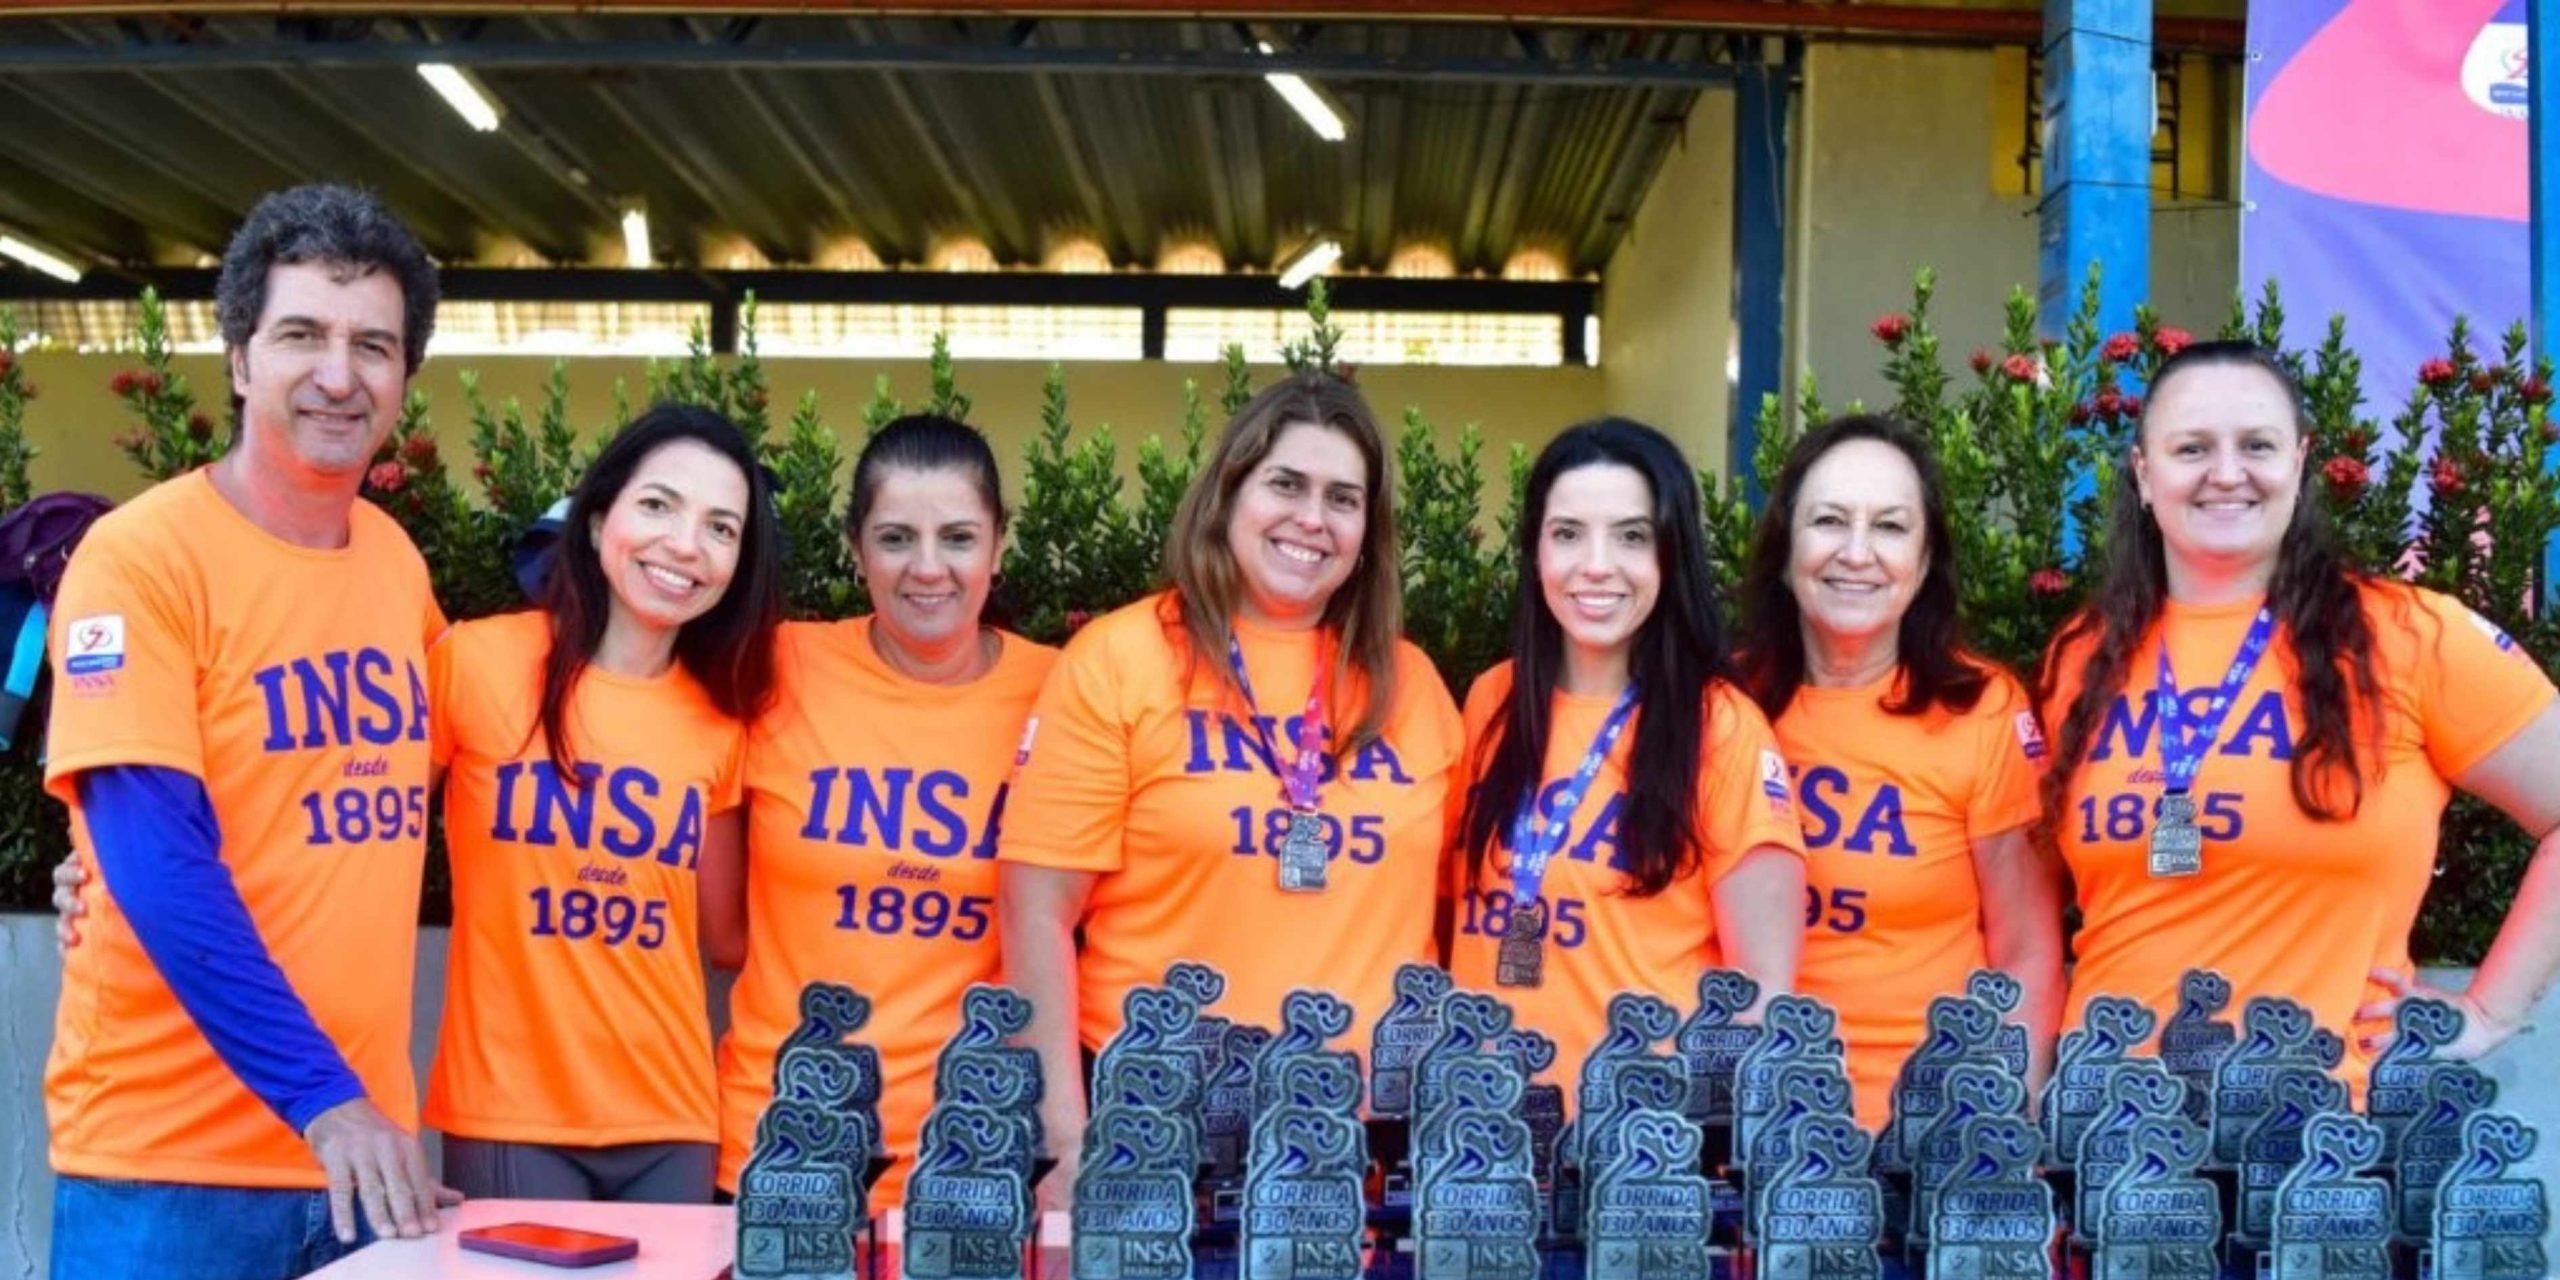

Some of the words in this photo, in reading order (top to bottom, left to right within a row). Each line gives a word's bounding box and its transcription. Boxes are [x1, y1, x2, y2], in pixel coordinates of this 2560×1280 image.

[344, 755, 388, 777] desde
[302, 786, 425, 844] 1895
[492, 760, 701, 870] INSA
[578, 863, 626, 885] desde
[888, 862, 941, 880] desde
[530, 886, 667, 949] 1895
[834, 884, 993, 941] 1895
[749, 1173, 841, 1195] CORRIDA
[917, 1181, 1008, 1200] CORRIDA
[1083, 1182, 1178, 1202] CORRIDA
[1256, 1183, 1350, 1203] CORRIDA
[1433, 1185, 1525, 1207] CORRIDA
[1605, 1187, 1697, 1207] CORRIDA
[1775, 1190, 1869, 1209] CORRIDA
[1946, 1191, 2039, 1211] CORRIDA
[2114, 1192, 2206, 1210] CORRIDA
[2288, 1190, 2380, 1209] CORRIDA
[2449, 1187, 2537, 1206] CORRIDA
[747, 1202, 780, 1220] 130
[785, 1202, 842, 1219] ANOS
[914, 1206, 947, 1224] 130
[951, 1207, 1009, 1226] ANOS
[1081, 1209, 1114, 1228] 130
[1119, 1209, 1178, 1228] ANOS
[1254, 1210, 1286, 1230] 130
[1292, 1210, 1351, 1231] ANOS
[1429, 1214, 1461, 1232] 130
[1467, 1214, 1526, 1231] ANOS
[1602, 1215, 1634, 1232] 130
[1640, 1215, 1698, 1232] ANOS
[1773, 1218, 1806, 1237] 130
[1810, 1218, 1870, 1237] ANOS
[1943, 1219, 1976, 1238] 130
[1981, 1219, 2041, 1238] ANOS
[2111, 1219, 2144, 1237] 130
[2150, 1219, 2208, 1237] ANOS
[2284, 1218, 2318, 1237] 130
[2323, 1218, 2380, 1237] ANOS
[2446, 1214, 2479, 1234] 130
[2484, 1213, 2539, 1232] ANOS
[788, 1232, 845, 1257] INSA
[957, 1238, 1011, 1261] INSA
[1126, 1240, 1182, 1264] INSA
[1297, 1242, 1354, 1264] INSA
[1473, 1245, 1530, 1268] INSA
[1645, 1246, 1699, 1269] INSA
[1815, 1248, 1873, 1271] INSA
[1986, 1250, 2042, 1272] INSA
[2155, 1249, 2209, 1273] INSA
[2327, 1248, 2382, 1271] INSA
[2488, 1245, 2543, 1269] INSA
